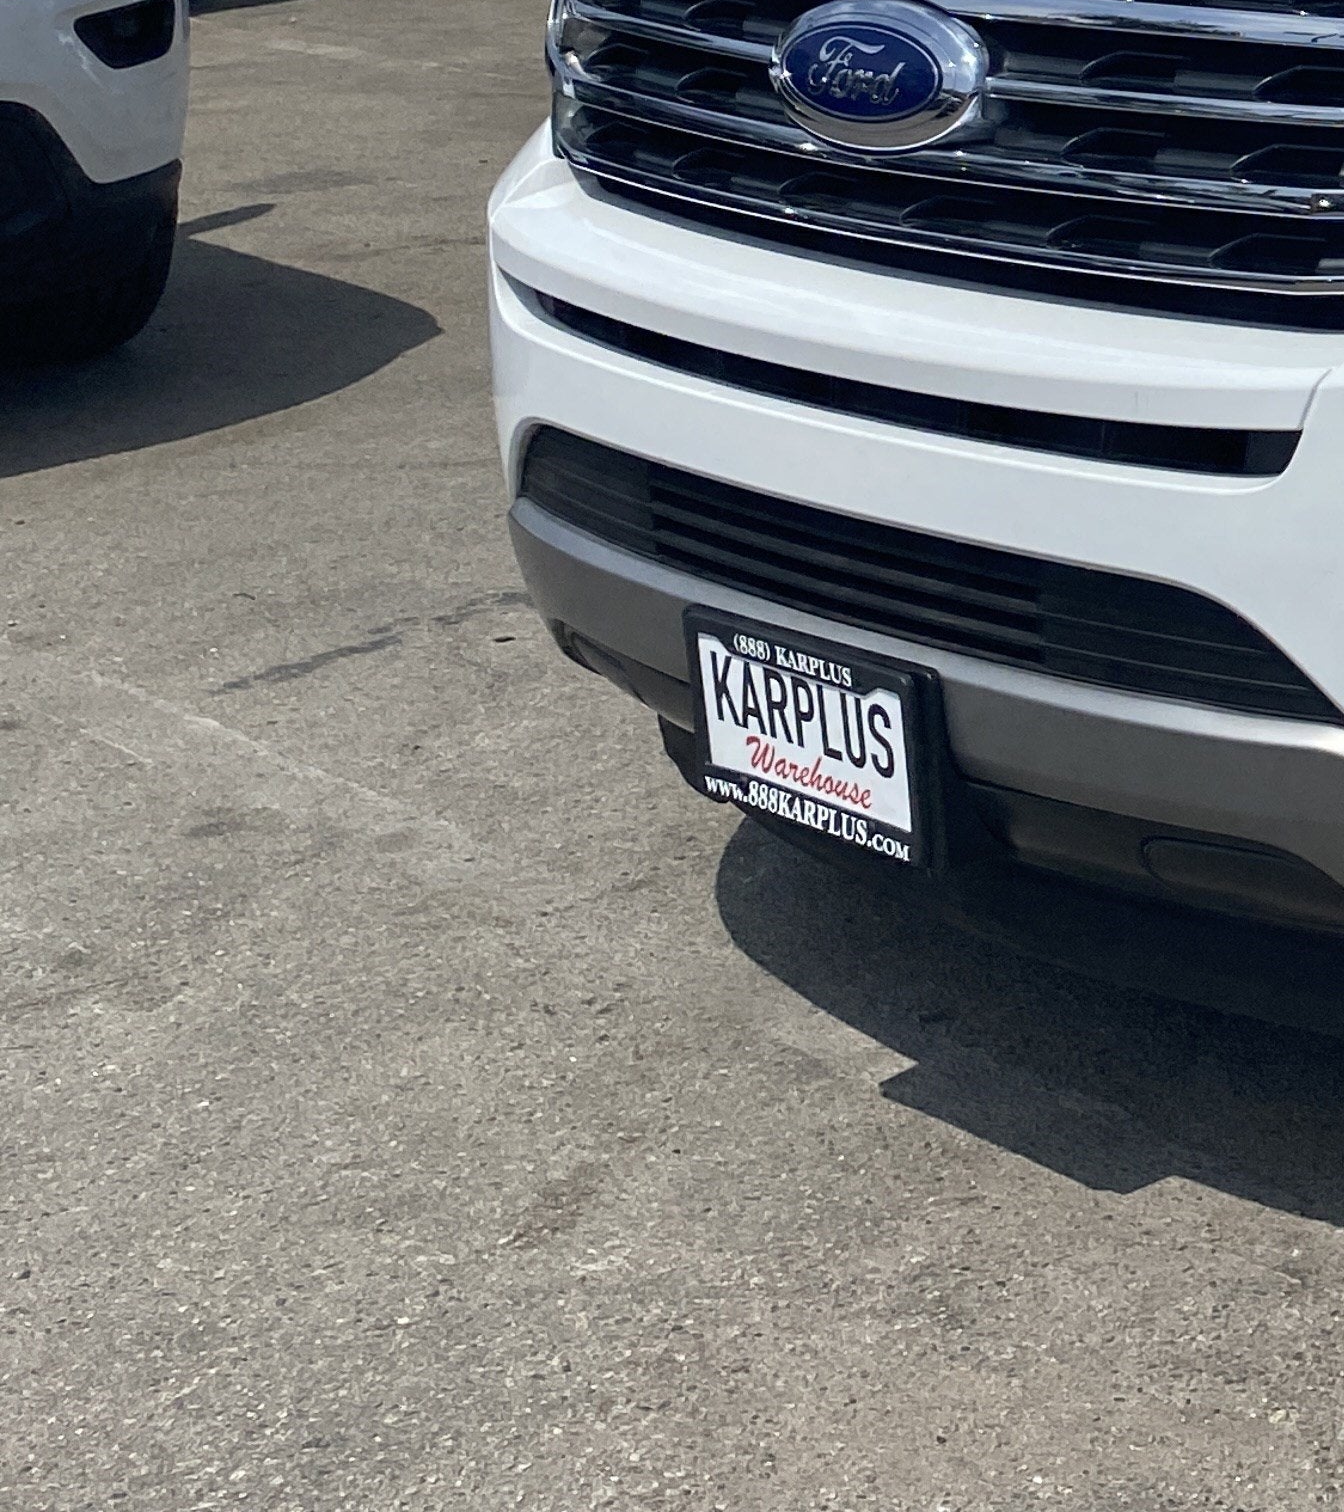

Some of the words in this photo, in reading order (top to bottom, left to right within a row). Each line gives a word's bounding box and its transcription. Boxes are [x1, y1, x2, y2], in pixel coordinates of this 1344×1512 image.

[807, 36, 907, 106] Ford
[733, 633, 771, 661] (888)
[775, 645, 852, 687] KARPLUS
[710, 651, 895, 779] KARPLUS
[746, 736, 872, 809] Warehouse
